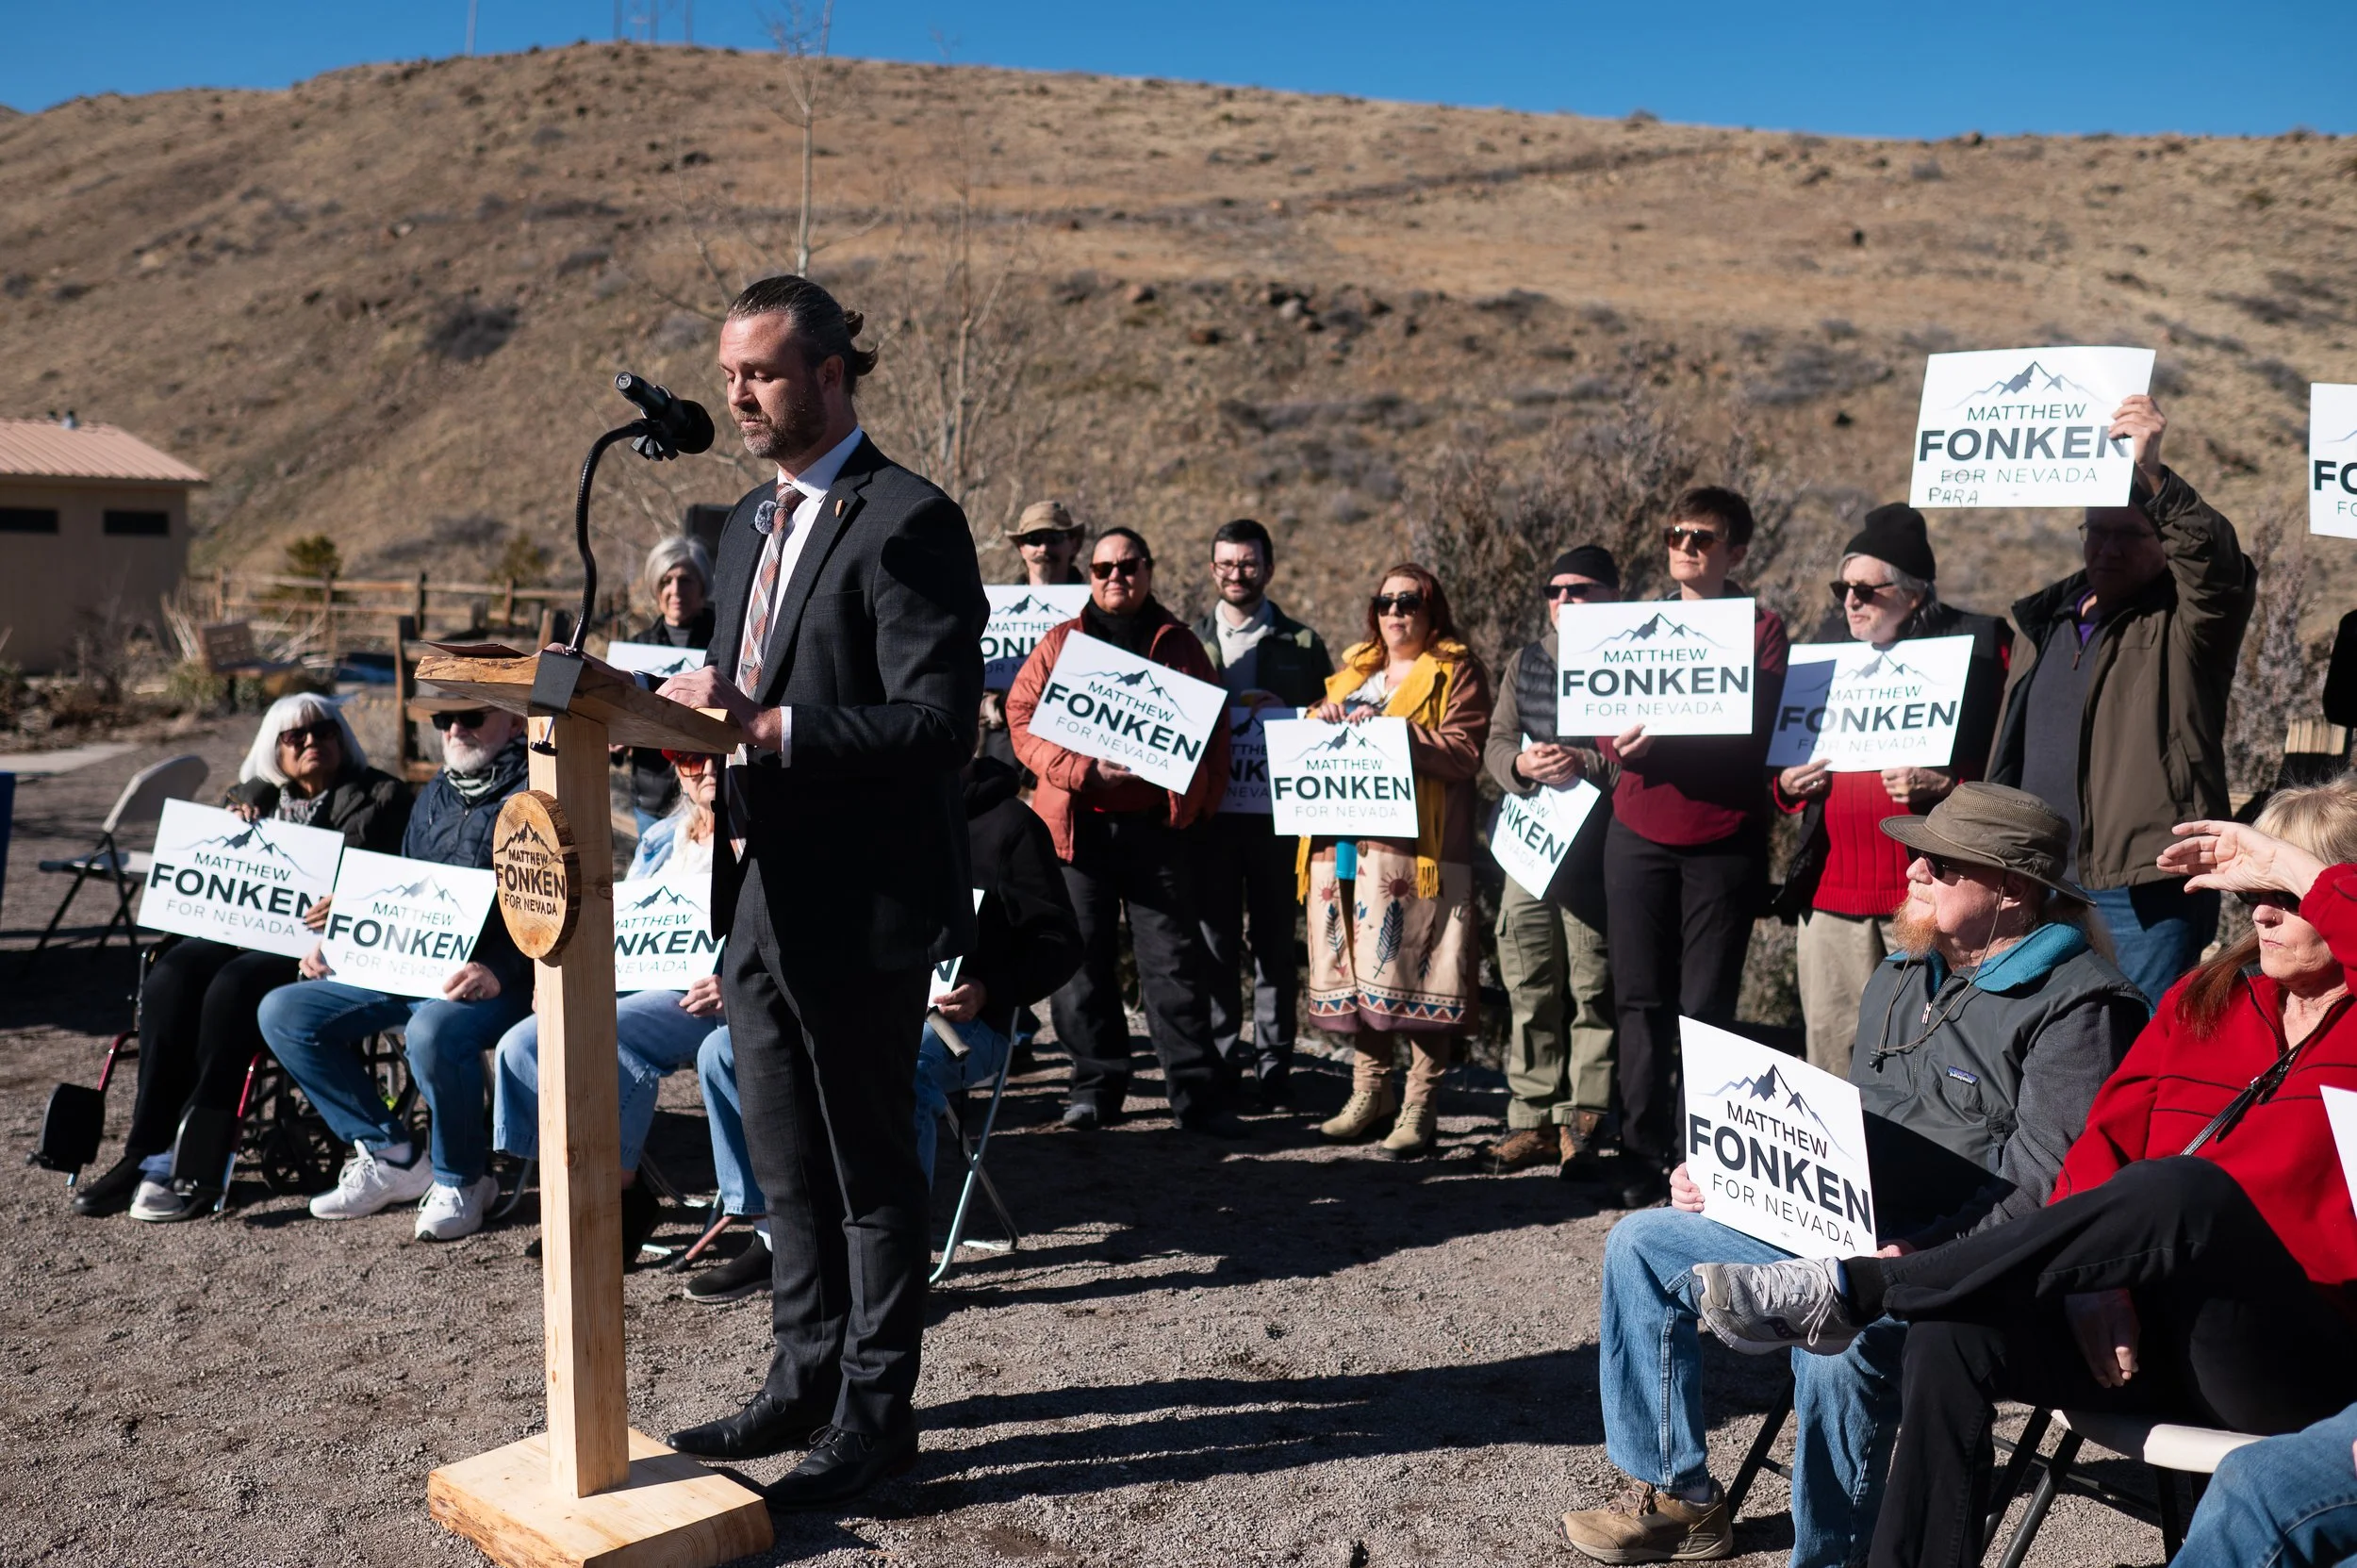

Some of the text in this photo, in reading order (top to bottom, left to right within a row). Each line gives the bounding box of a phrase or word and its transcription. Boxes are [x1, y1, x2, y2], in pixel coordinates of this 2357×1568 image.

[1967, 403, 2087, 421] MATTHEW
[1997, 468, 2098, 483] NEVADA
[1928, 487, 1978, 507] PARA
[987, 622, 1058, 633] MATTHE
[1604, 648, 1707, 663] MATTHEW
[1562, 666, 1749, 697] FONKEN
[1825, 685, 1922, 701] MATTHEW
[1088, 681, 1174, 722] MATTHEW
[1585, 701, 1723, 717] FOR NEVADA
[1044, 682, 1202, 763] FONKEN
[1777, 701, 1957, 734] FONKEN
[1056, 716, 1169, 770] FOR NEVADA
[1797, 735, 1927, 752] FOR NEVADA
[1306, 759, 1382, 770] MATTHEW
[1274, 776, 1411, 801] FONKEN
[1294, 806, 1398, 817] FOR NEVADA
[1503, 796, 1566, 865] NKEN
[194, 852, 291, 882] MATTHEW
[508, 850, 549, 866] MATTHEW
[495, 863, 566, 900] FONKEN
[372, 902, 455, 926] MATTHEW
[504, 893, 558, 916] FOR NEVADA
[166, 899, 295, 937] FOR NEVADA
[327, 914, 474, 962] FONKEN
[343, 951, 444, 978] FOR NEVADA
[1726, 1100, 1827, 1160] MATTHEW
[1689, 1113, 1872, 1235] FONKEN
[1712, 1173, 1856, 1251] FOR NEVADA
